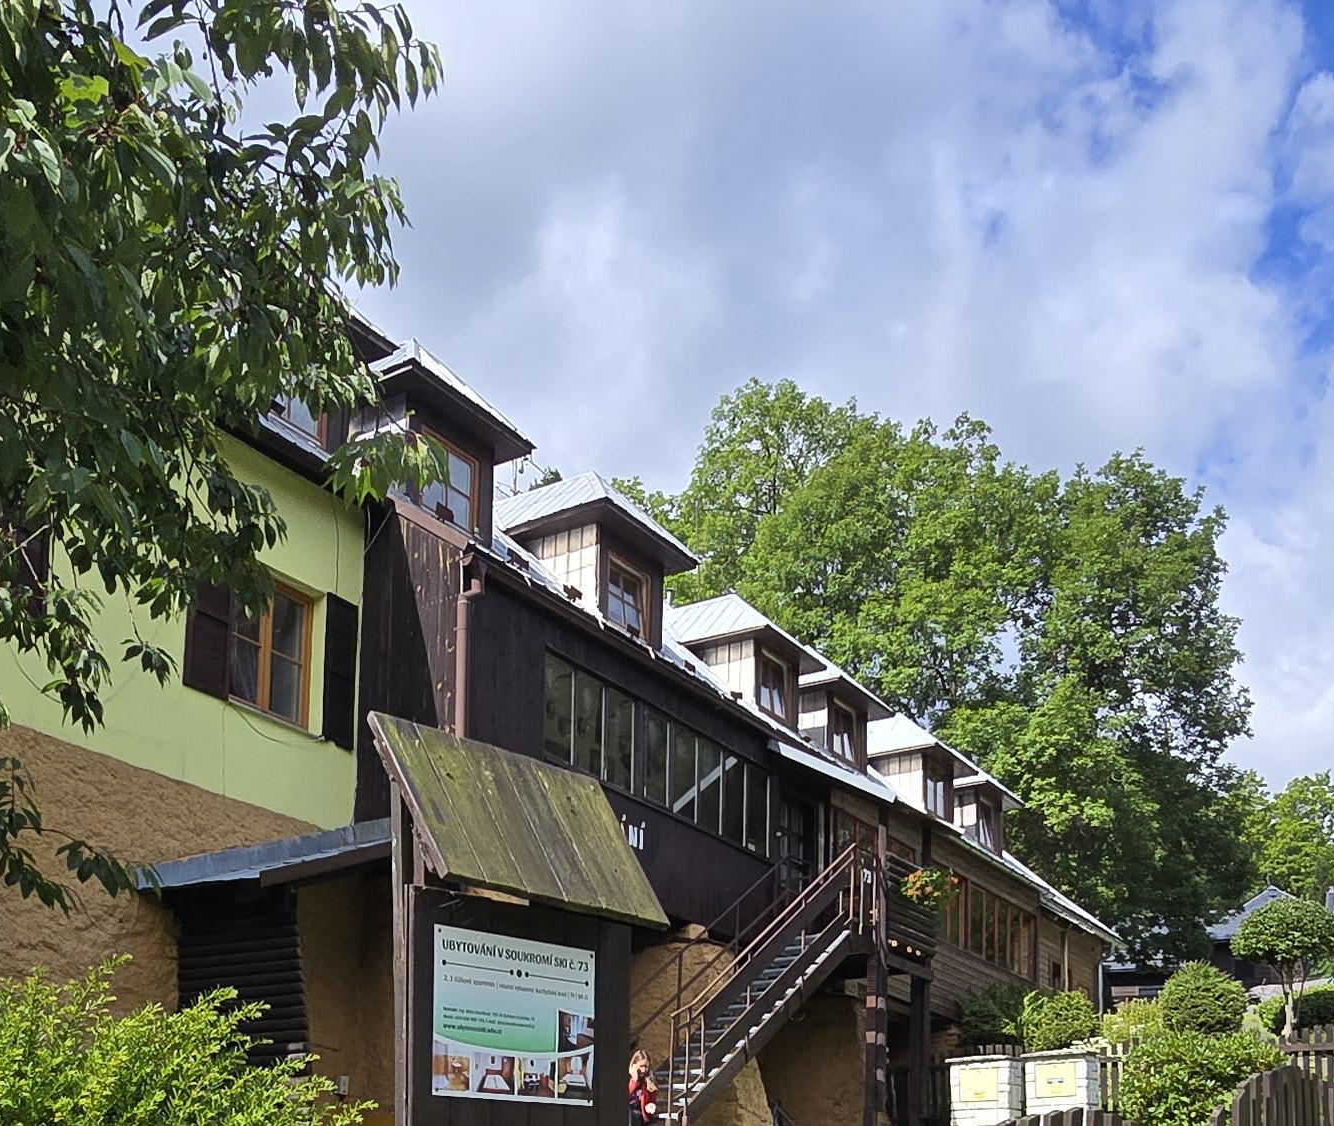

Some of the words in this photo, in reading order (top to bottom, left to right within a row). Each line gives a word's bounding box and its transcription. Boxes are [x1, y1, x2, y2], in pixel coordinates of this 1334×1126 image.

[442, 939, 496, 957] UBYTOVÁNÍ
[498, 948, 504, 958] V
[505, 949, 554, 966] SOUKROMÍ
[578, 961, 589, 972] 73
